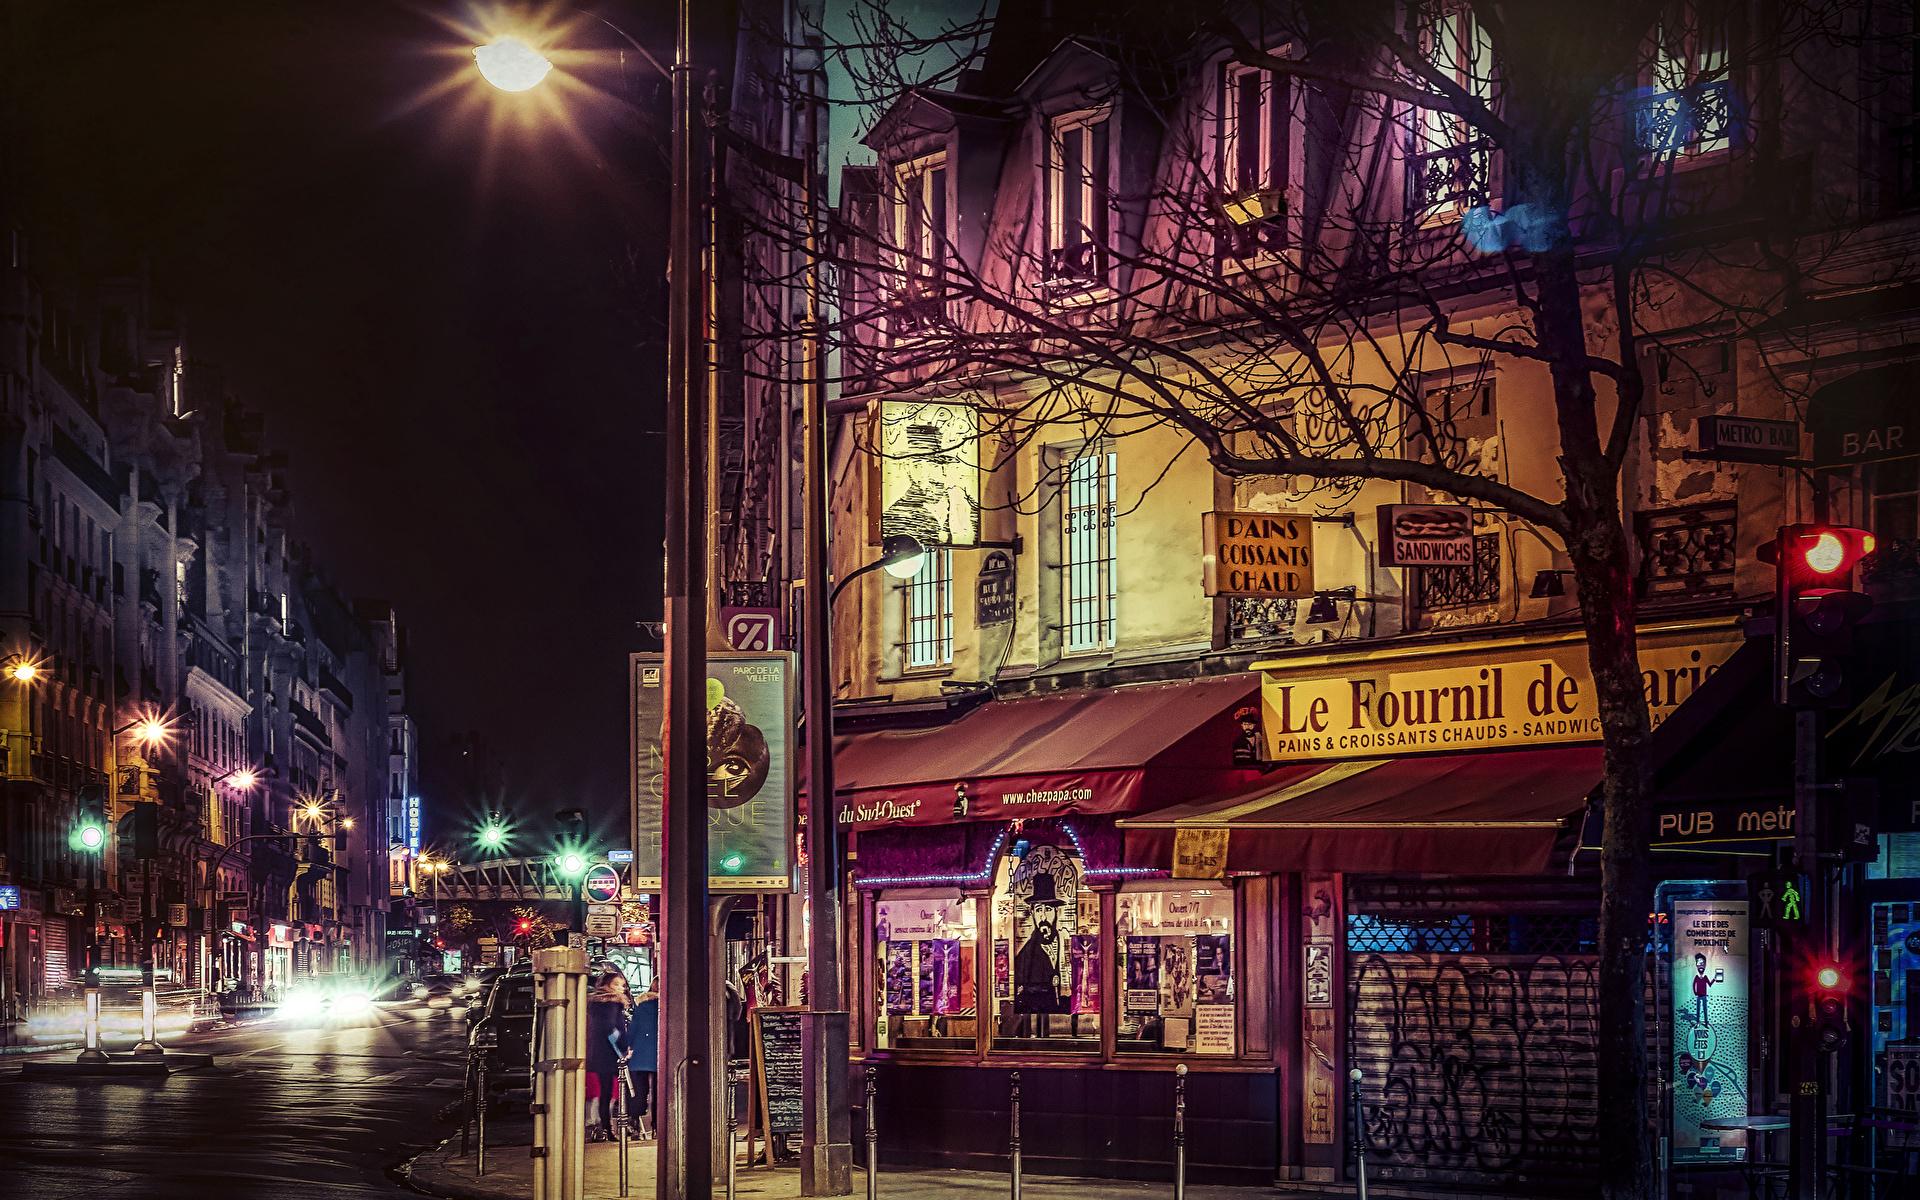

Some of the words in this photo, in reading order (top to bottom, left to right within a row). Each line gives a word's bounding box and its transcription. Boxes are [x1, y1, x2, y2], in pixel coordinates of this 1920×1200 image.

[1718, 423, 1762, 445] METRO
[1769, 428, 1794, 447] BAR
[1842, 425, 1904, 456] BAR
[1227, 518, 1299, 539] PAINS
[1218, 544, 1310, 567] COISSANTS
[1396, 542, 1471, 562] SANDWICHS
[1229, 570, 1300, 592] CHAUD
[733, 666, 755, 675] PARC
[756, 666, 767, 675] DE
[769, 666, 780, 675] LA
[747, 674, 780, 682] VILLETTE
[1277, 684, 1329, 735] Le
[1349, 669, 1505, 730] Fournil
[1527, 664, 1579, 716] de
[1640, 650, 1720, 708] ari
[1278, 735, 1322, 753] PAINS
[1325, 732, 1335, 750] &
[1339, 728, 1438, 749] CROISSANTS
[1442, 722, 1507, 743] CHAUDS
[1522, 717, 1601, 738] SANDWIC
[1002, 787, 1092, 806] www.chezpapa.com
[839, 804, 854, 824] du
[1659, 810, 1714, 836] PUB
[1736, 805, 1796, 832] metr
[409, 797, 419, 858] HOSTEL
[1686, 929, 1727, 938] COMMERCES
[1727, 930, 1737, 938] DE
[1693, 920, 1700, 928] LE
[1701, 920, 1716, 928] SITE
[1716, 920, 1729, 928] DES
